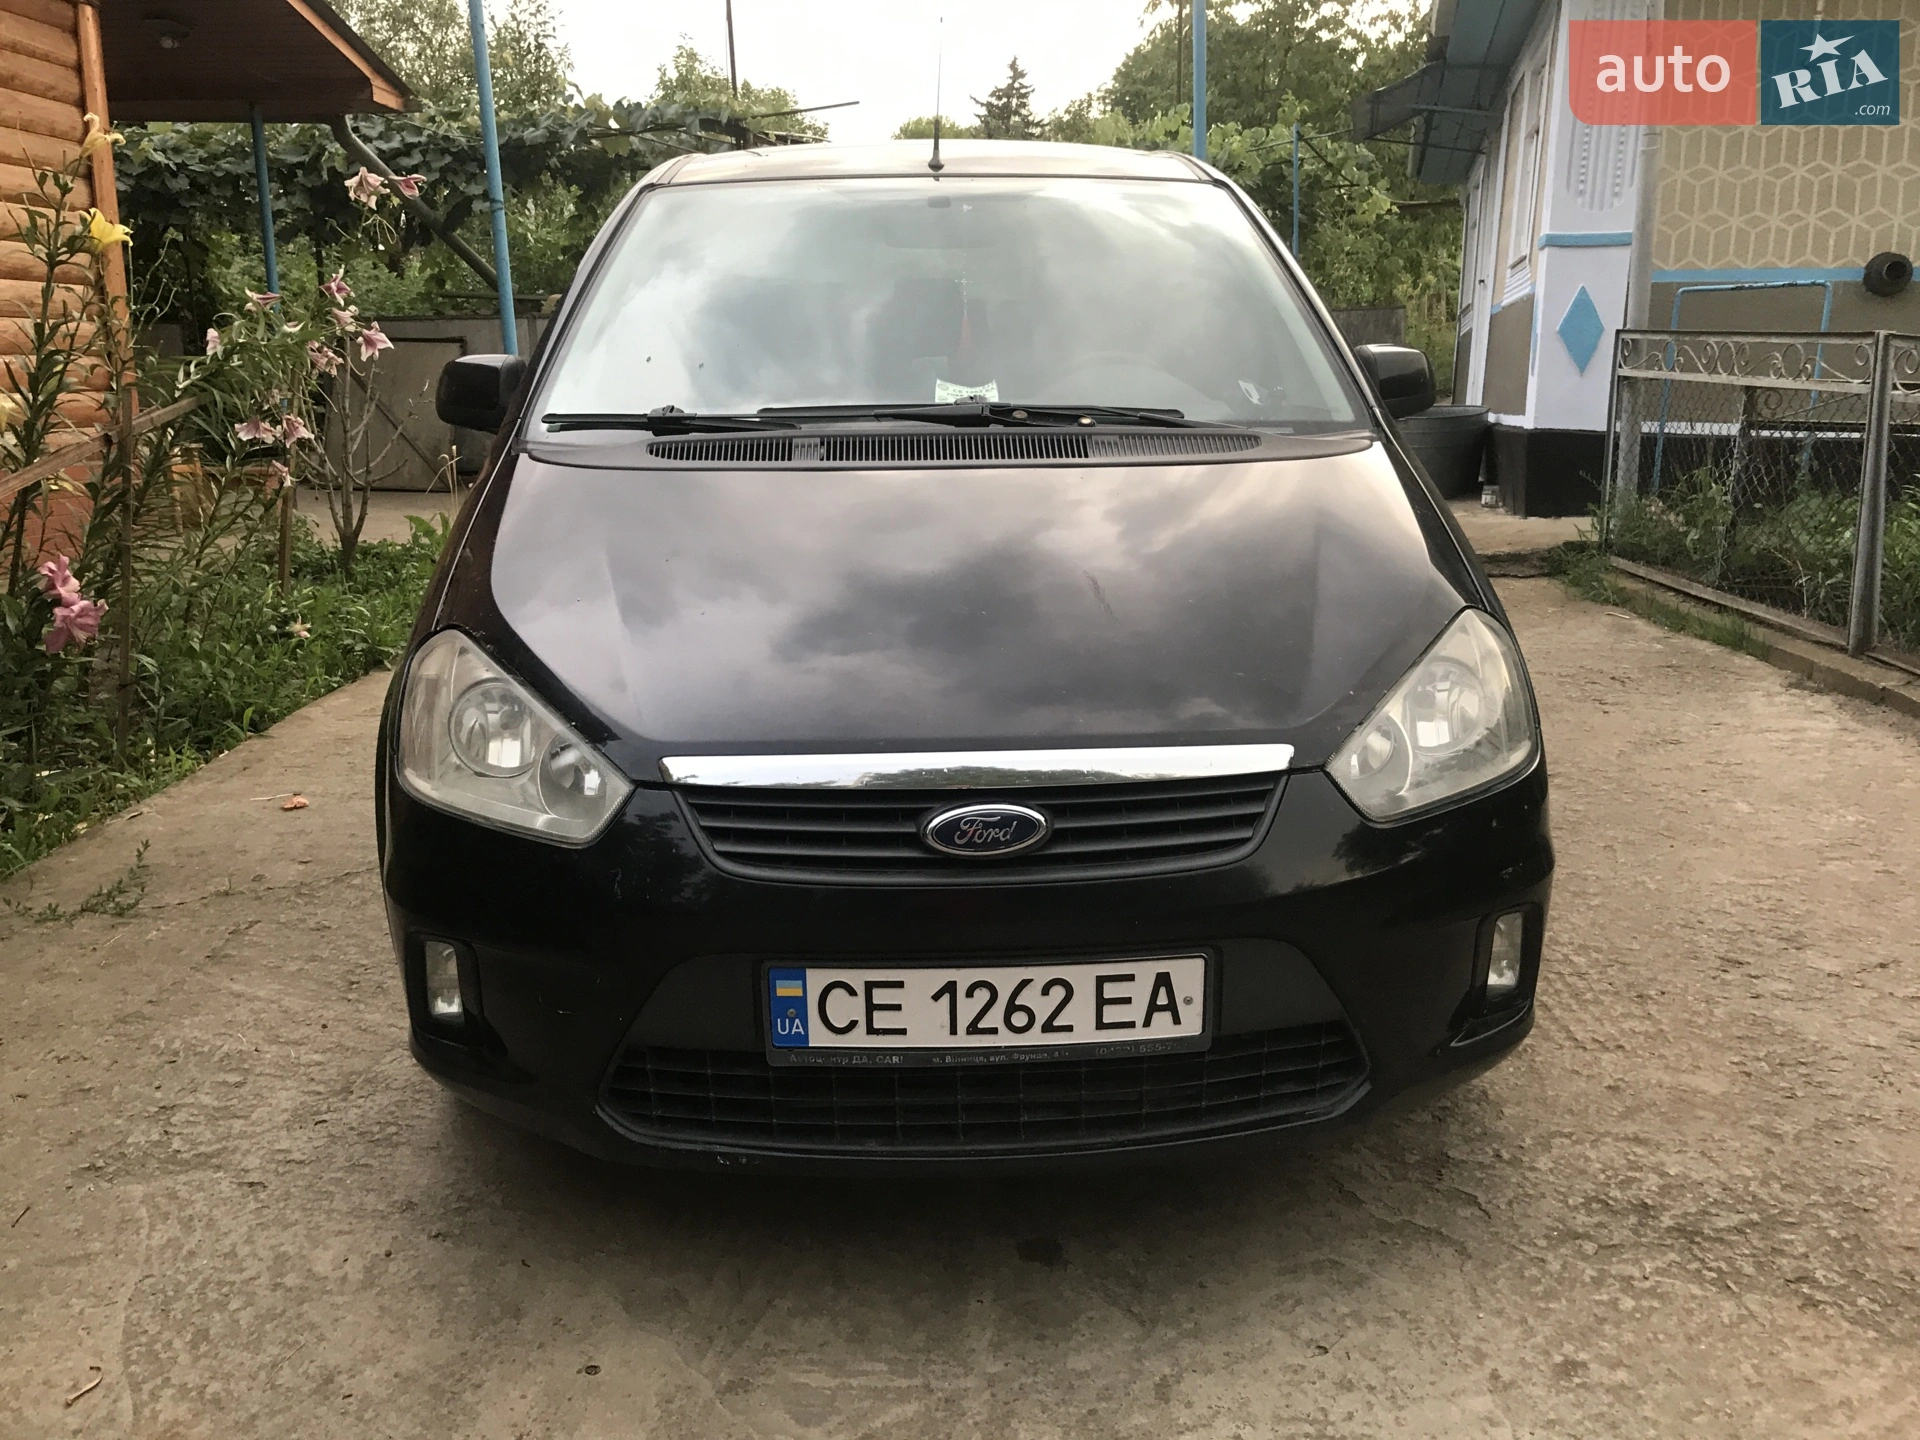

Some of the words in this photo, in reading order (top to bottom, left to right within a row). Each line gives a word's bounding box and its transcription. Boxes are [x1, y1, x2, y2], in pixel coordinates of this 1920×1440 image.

[954, 816, 1018, 845] Ford
[817, 980, 908, 1036] CE
[930, 978, 1075, 1036] 1262
[1095, 971, 1182, 1031] EA
[777, 1018, 805, 1035] UA
